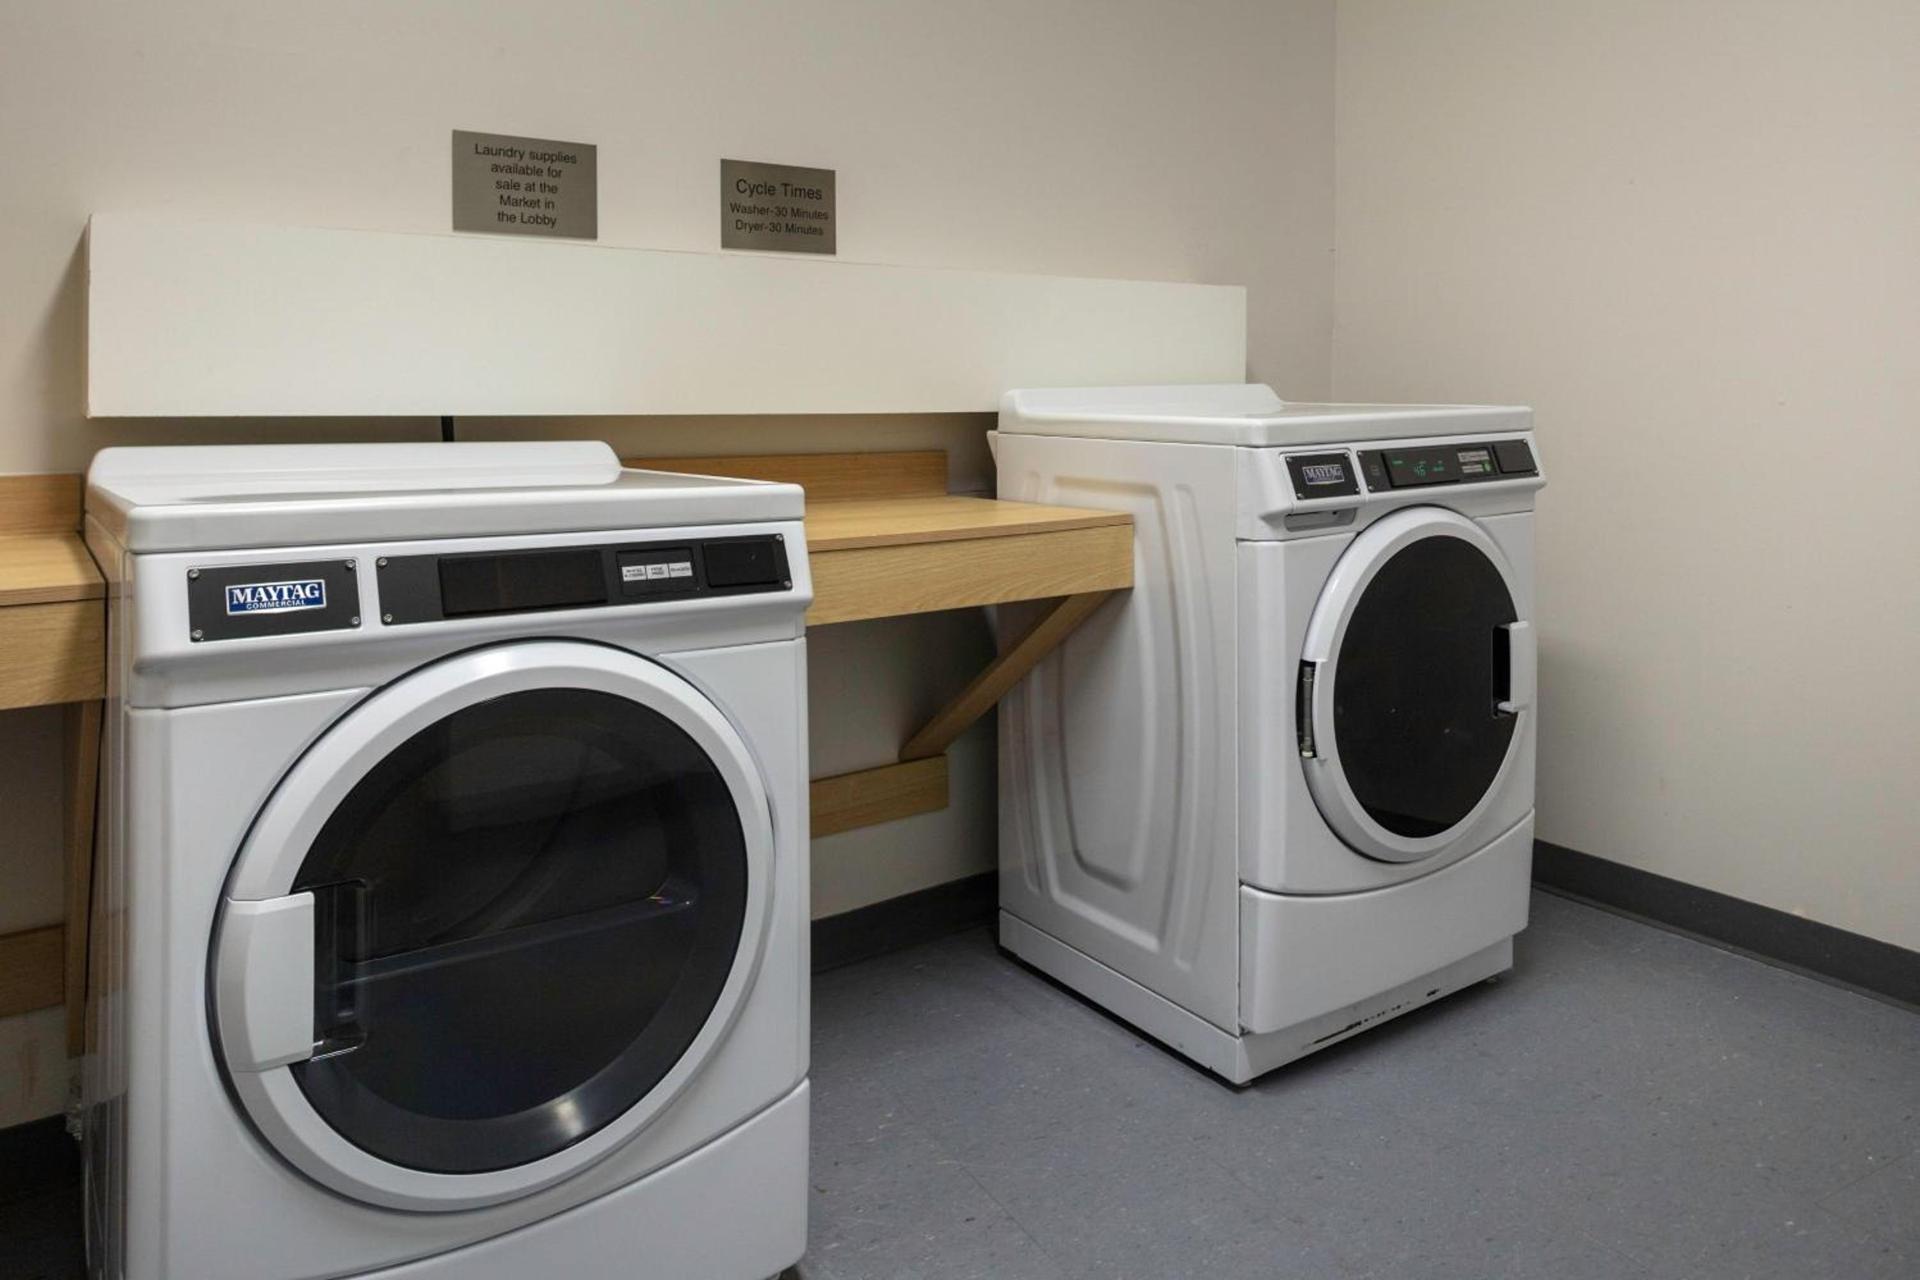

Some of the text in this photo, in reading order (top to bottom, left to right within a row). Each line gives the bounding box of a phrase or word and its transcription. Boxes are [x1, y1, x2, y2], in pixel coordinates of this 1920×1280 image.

[474, 143, 577, 164] Laundry supplies
[491, 162, 562, 178] available for
[495, 179, 558, 194] sale at the
[736, 178, 823, 200] Cycle Times
[500, 194, 555, 209] Market in
[729, 202, 829, 220] Washer-30 Minutes
[497, 211, 557, 229] the Lobby
[735, 219, 824, 236] Dryer-30 Minutes
[231, 583, 320, 605] MAYTAG
[246, 600, 306, 610] COMMERCIAL
